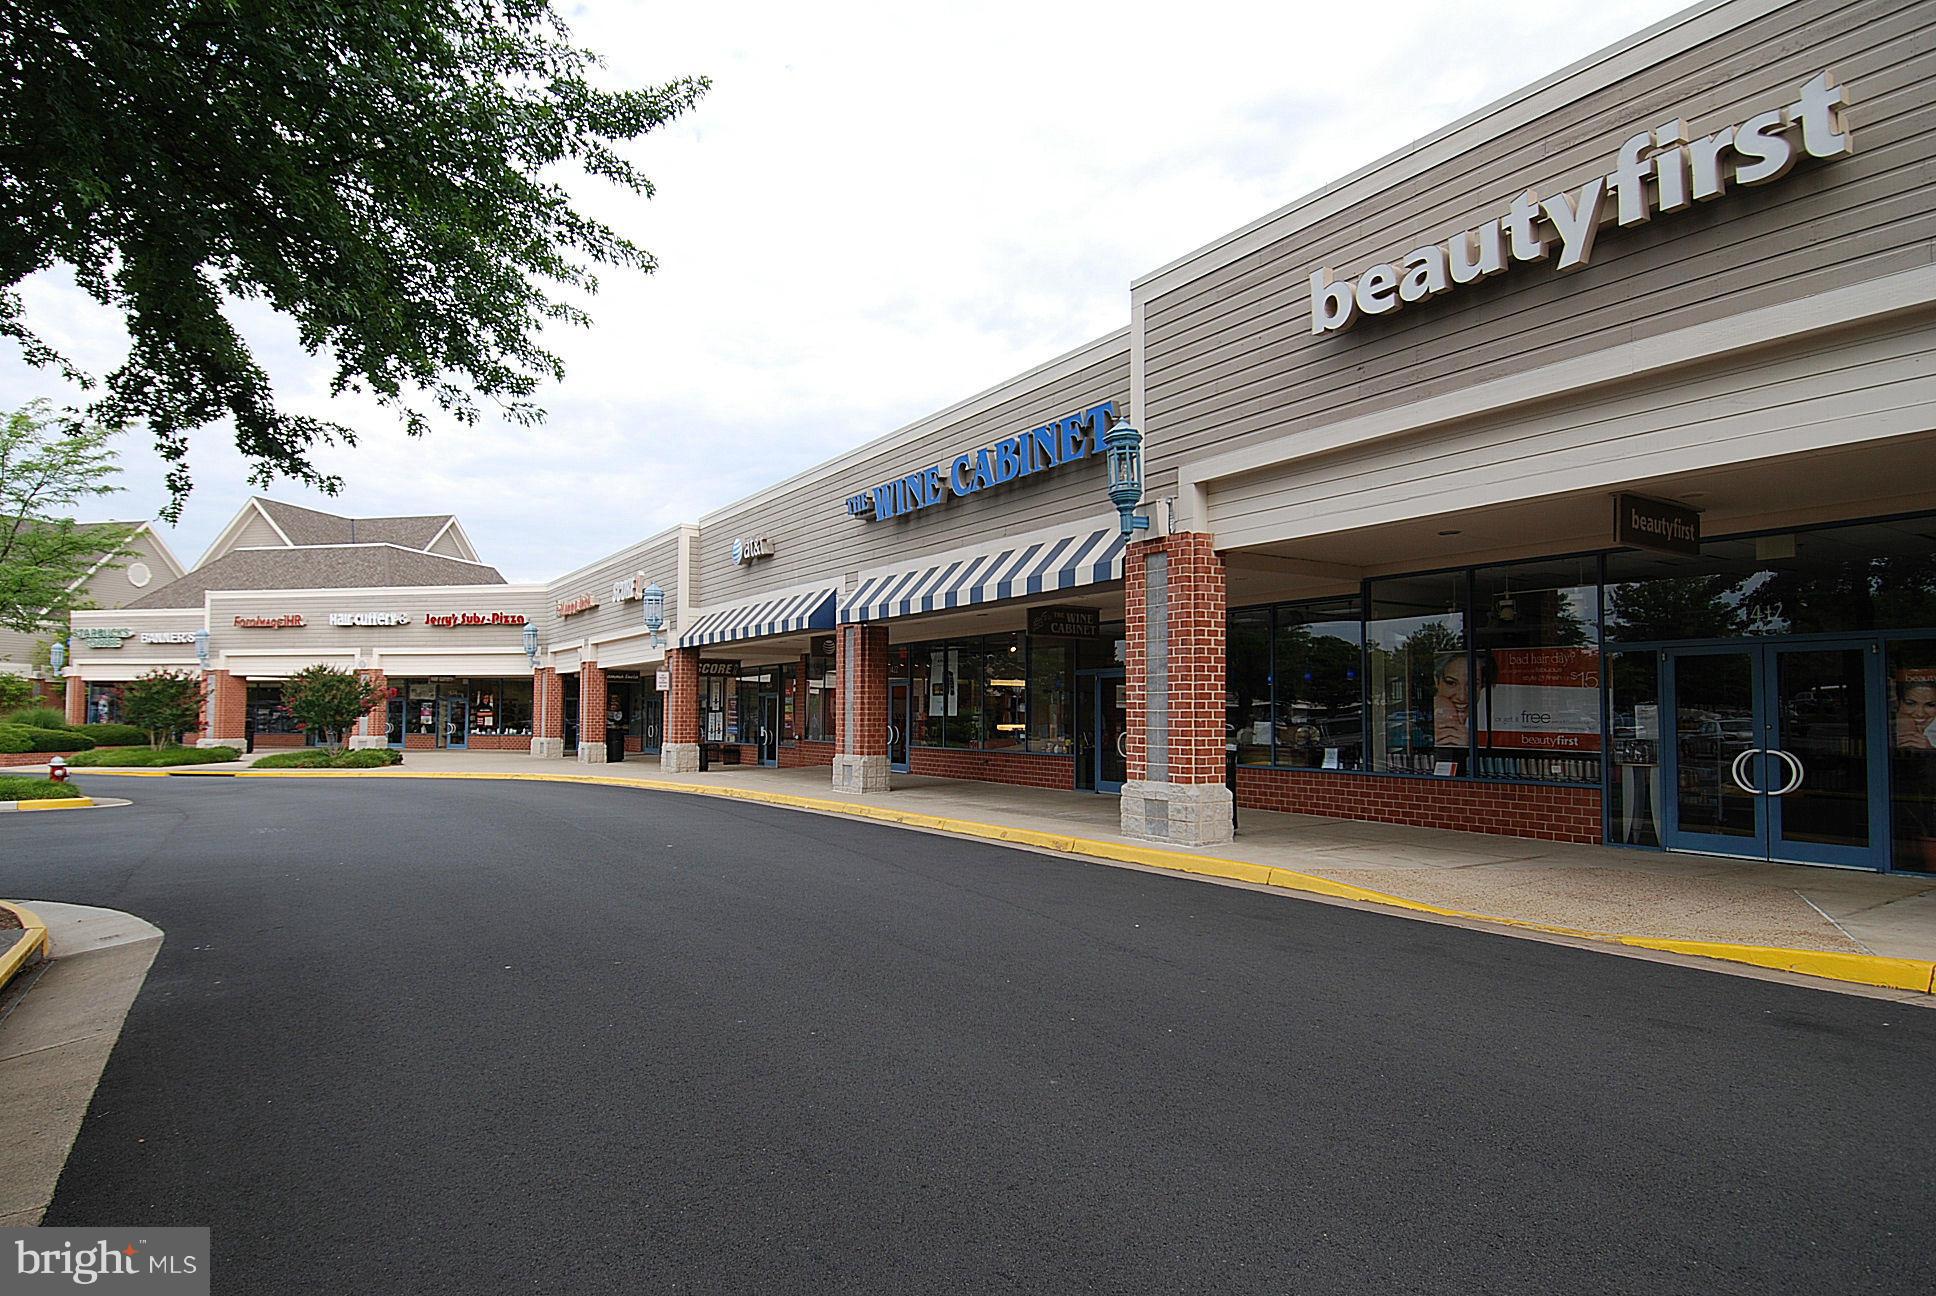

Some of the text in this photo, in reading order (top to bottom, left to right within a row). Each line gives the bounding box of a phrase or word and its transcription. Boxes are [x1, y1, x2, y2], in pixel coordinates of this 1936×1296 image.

[1309, 69, 1853, 336] beautyfirst
[846, 400, 1115, 522] THE WINE CABINET
[1631, 507, 1696, 542] beautyfirst
[425, 612, 525, 627] Jerry's Subs Pizza
[1065, 612, 1094, 624] WINE
[1050, 622, 1097, 635] CABINET
[1509, 651, 1576, 667] bad hair day?
[1570, 671, 1599, 688] $15
[1521, 710, 1551, 724] free
[1521, 734, 1579, 747] beautyfirst
